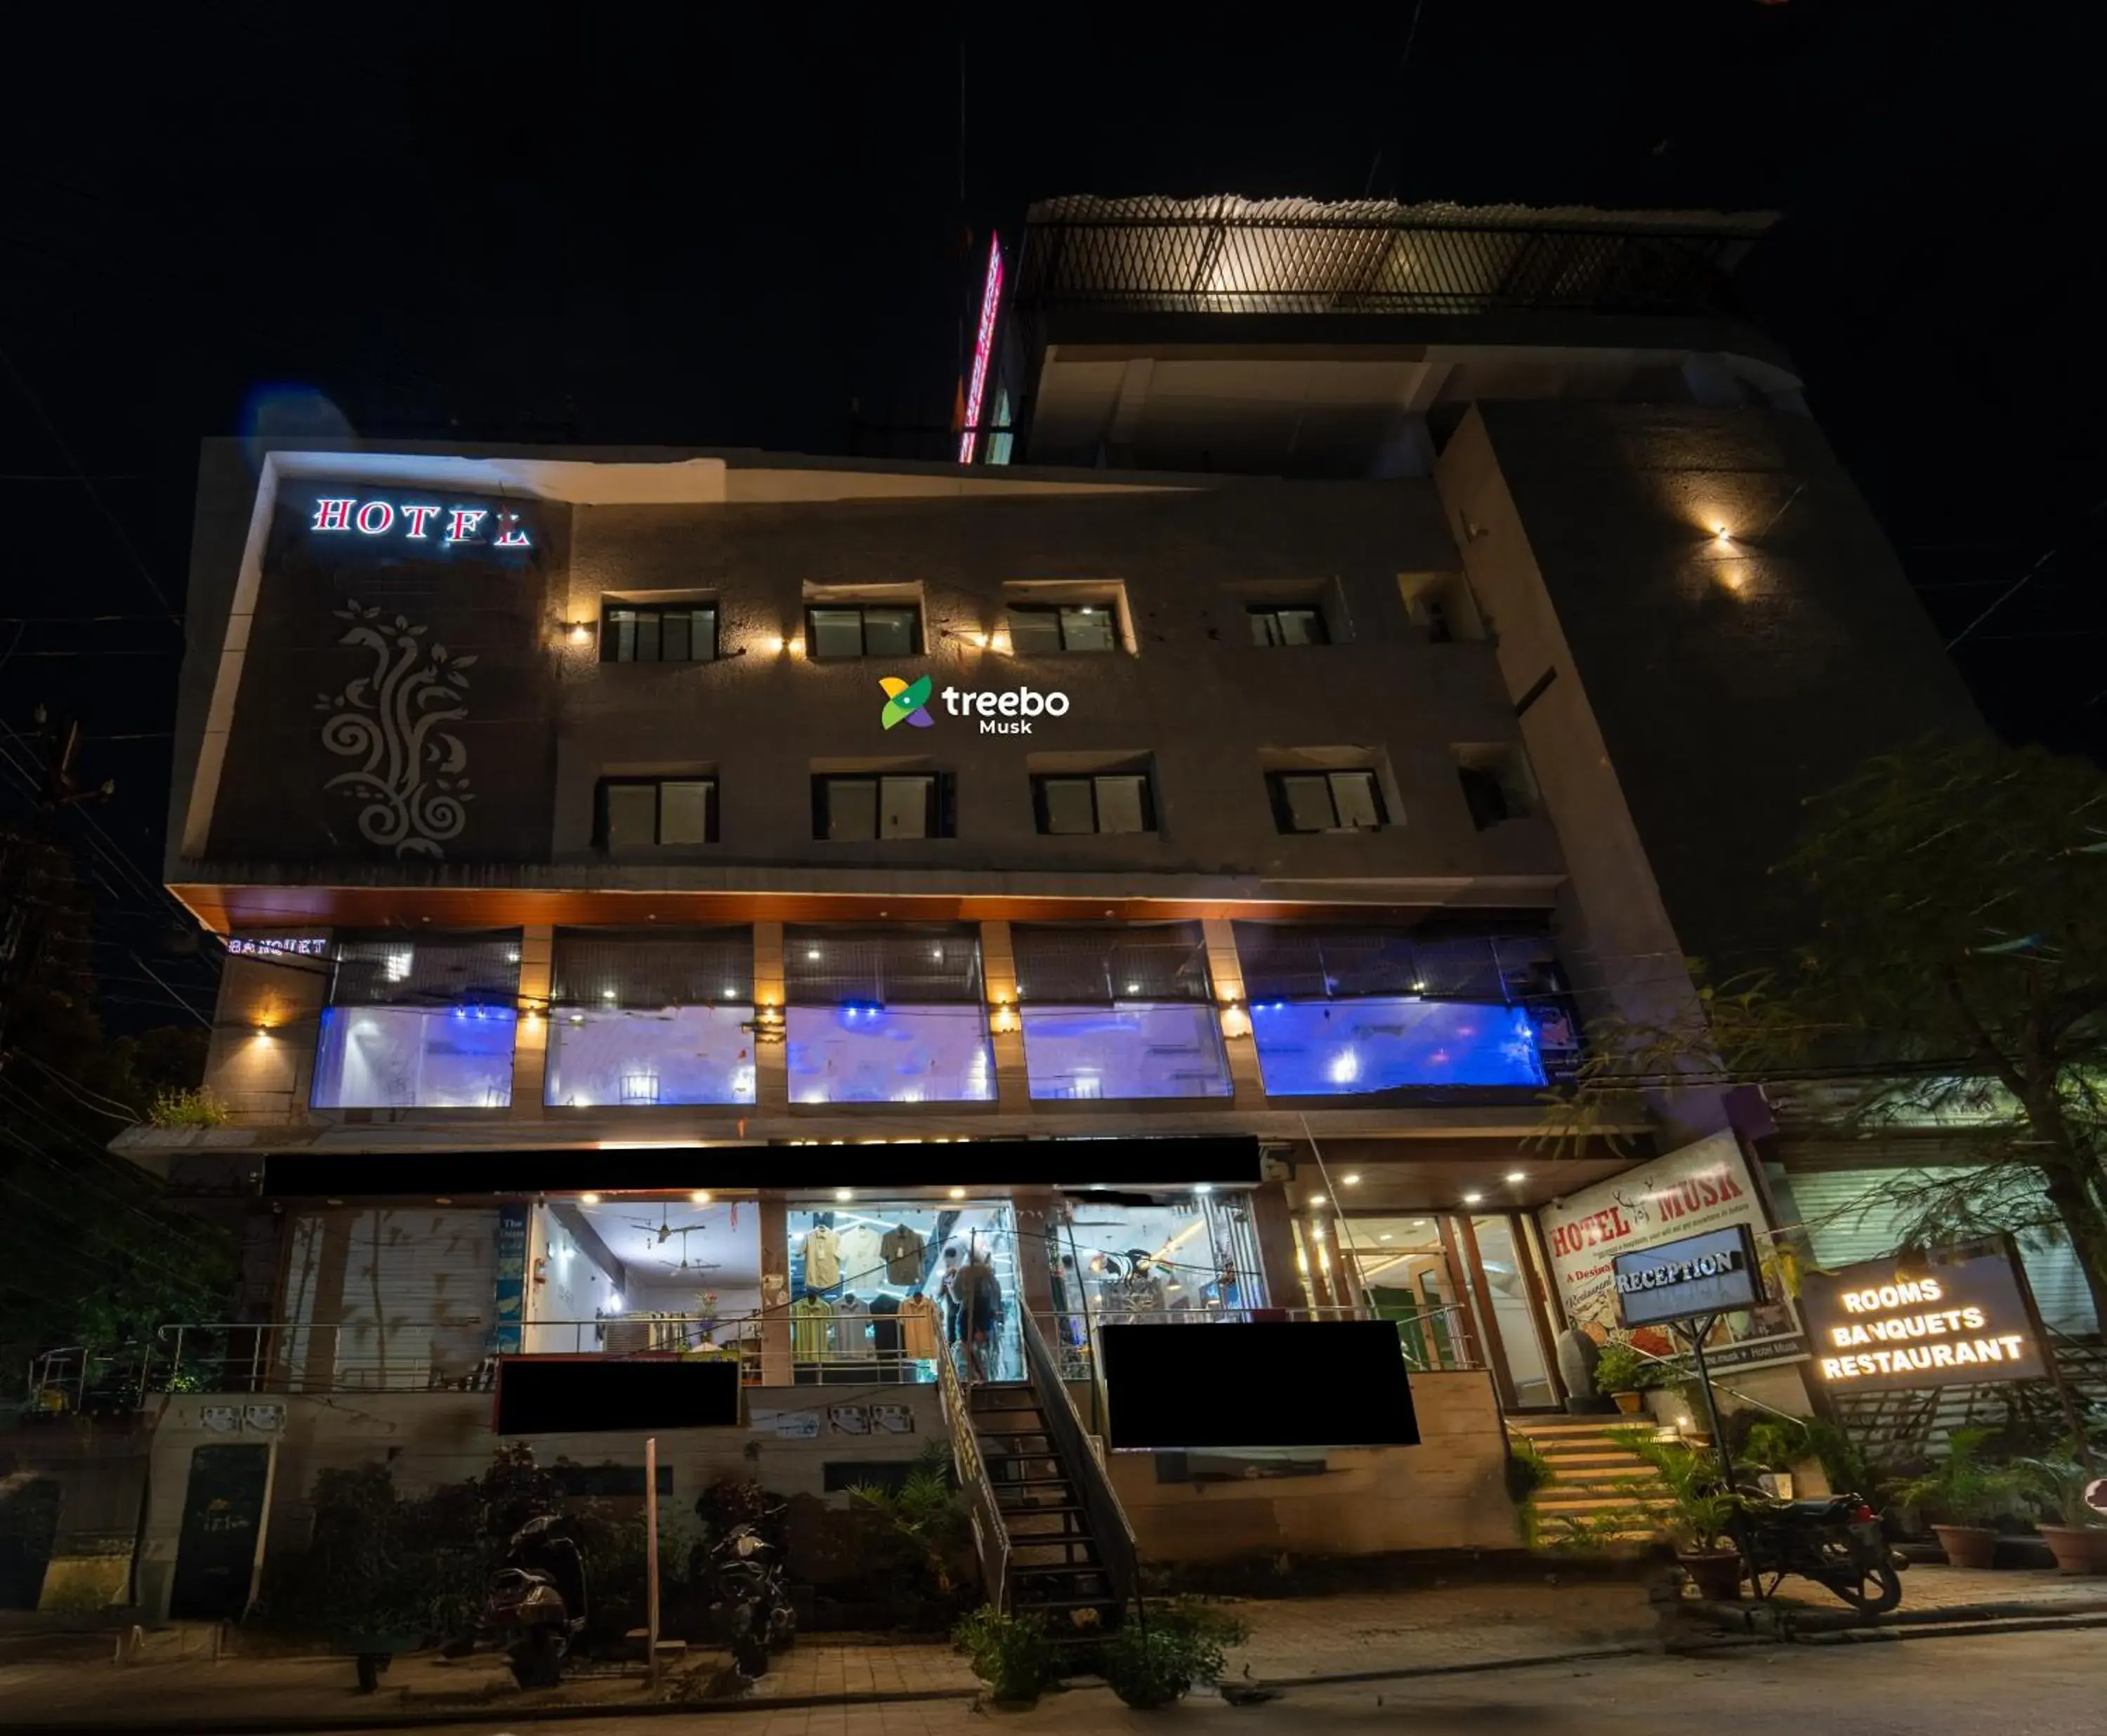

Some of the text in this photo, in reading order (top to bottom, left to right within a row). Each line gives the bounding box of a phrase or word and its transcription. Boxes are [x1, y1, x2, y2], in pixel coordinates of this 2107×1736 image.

[228, 939, 327, 956] BANQUET
[1549, 1171, 1743, 1257] HOTEL MUSK
[1617, 1251, 1733, 1293] RECEPTION
[1842, 1278, 1942, 1313] ROOMS
[1832, 1307, 1985, 1347] BANQUETS
[1820, 1335, 2023, 1380] RESTAURANT
